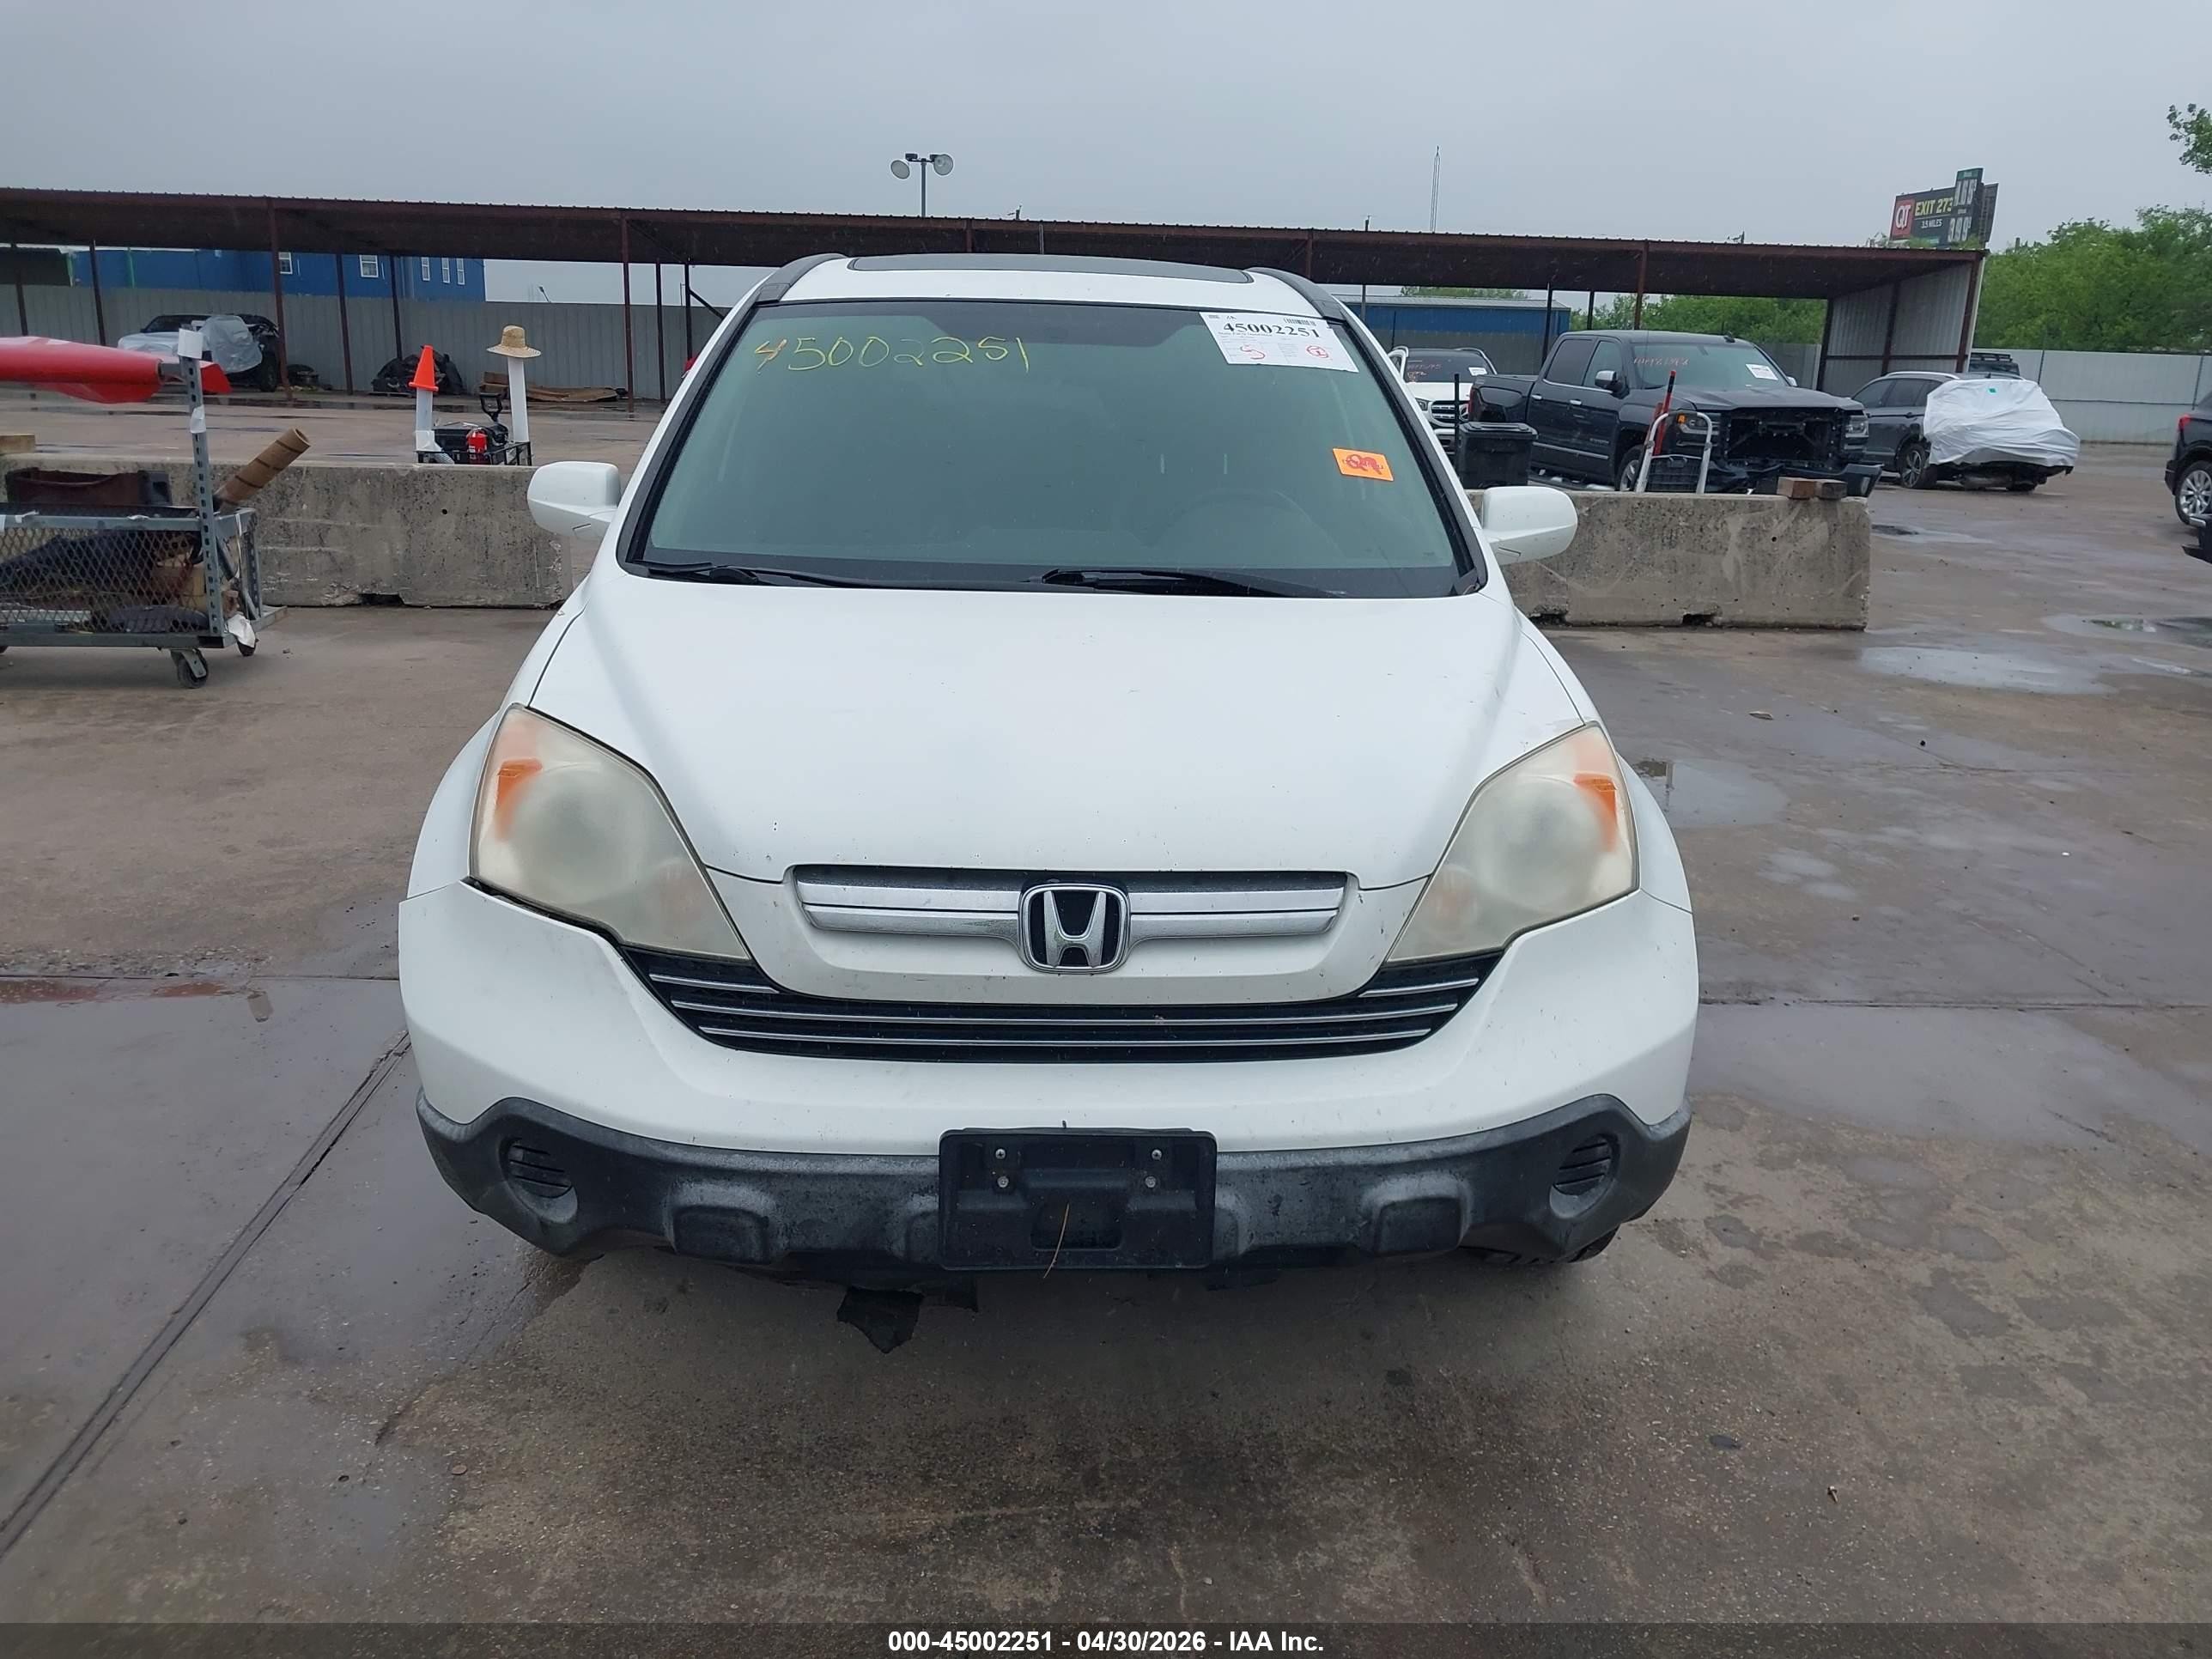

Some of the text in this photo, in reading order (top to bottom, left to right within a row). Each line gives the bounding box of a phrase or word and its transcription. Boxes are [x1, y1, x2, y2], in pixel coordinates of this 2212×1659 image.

[1914, 199, 1936, 216] EXIT
[1895, 204, 1911, 230] QT
[1929, 219, 1943, 228] MILES
[1223, 322, 1321, 338] 45002251
[755, 336, 1030, 374] 45002251
